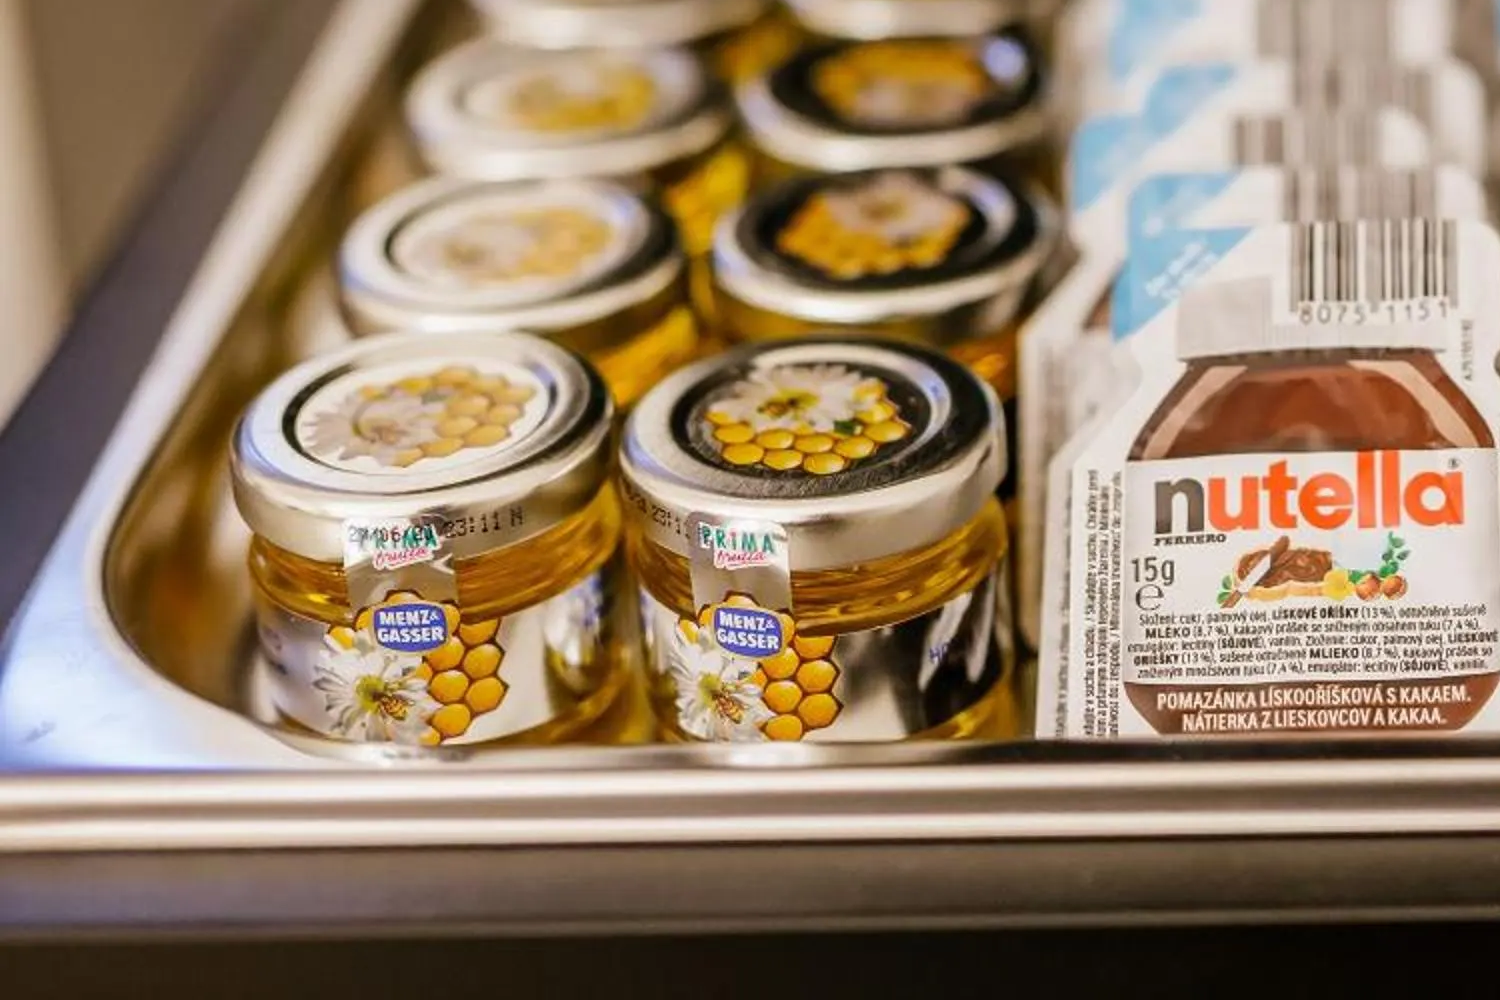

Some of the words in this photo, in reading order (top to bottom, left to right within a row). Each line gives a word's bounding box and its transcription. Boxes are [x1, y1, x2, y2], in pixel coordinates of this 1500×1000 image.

[1300, 303, 1366, 325] 8075
[1387, 301, 1447, 324] 1151
[1154, 449, 1464, 534] nutella
[1154, 533, 1227, 548] FERRERO
[1131, 557, 1175, 585] 15g
[377, 624, 446, 644] GASSER
[717, 627, 779, 650] GASSER
[1145, 624, 1190, 639] MLÉKO
[1309, 646, 1359, 660] MLIEKO
[1156, 687, 1257, 711] POMAZÁNKA
[1260, 683, 1383, 708] LÍSKOOŘÍŠKOVÁ
[1386, 687, 1396, 703] S
[1399, 684, 1471, 704] KAKAEM.
[1182, 709, 1257, 732] NÁTIERKA
[1261, 711, 1272, 728] Z
[1274, 708, 1371, 727] LIESKOVCOV
[1373, 709, 1385, 725] A
[1387, 707, 1447, 725] KAKAA.
